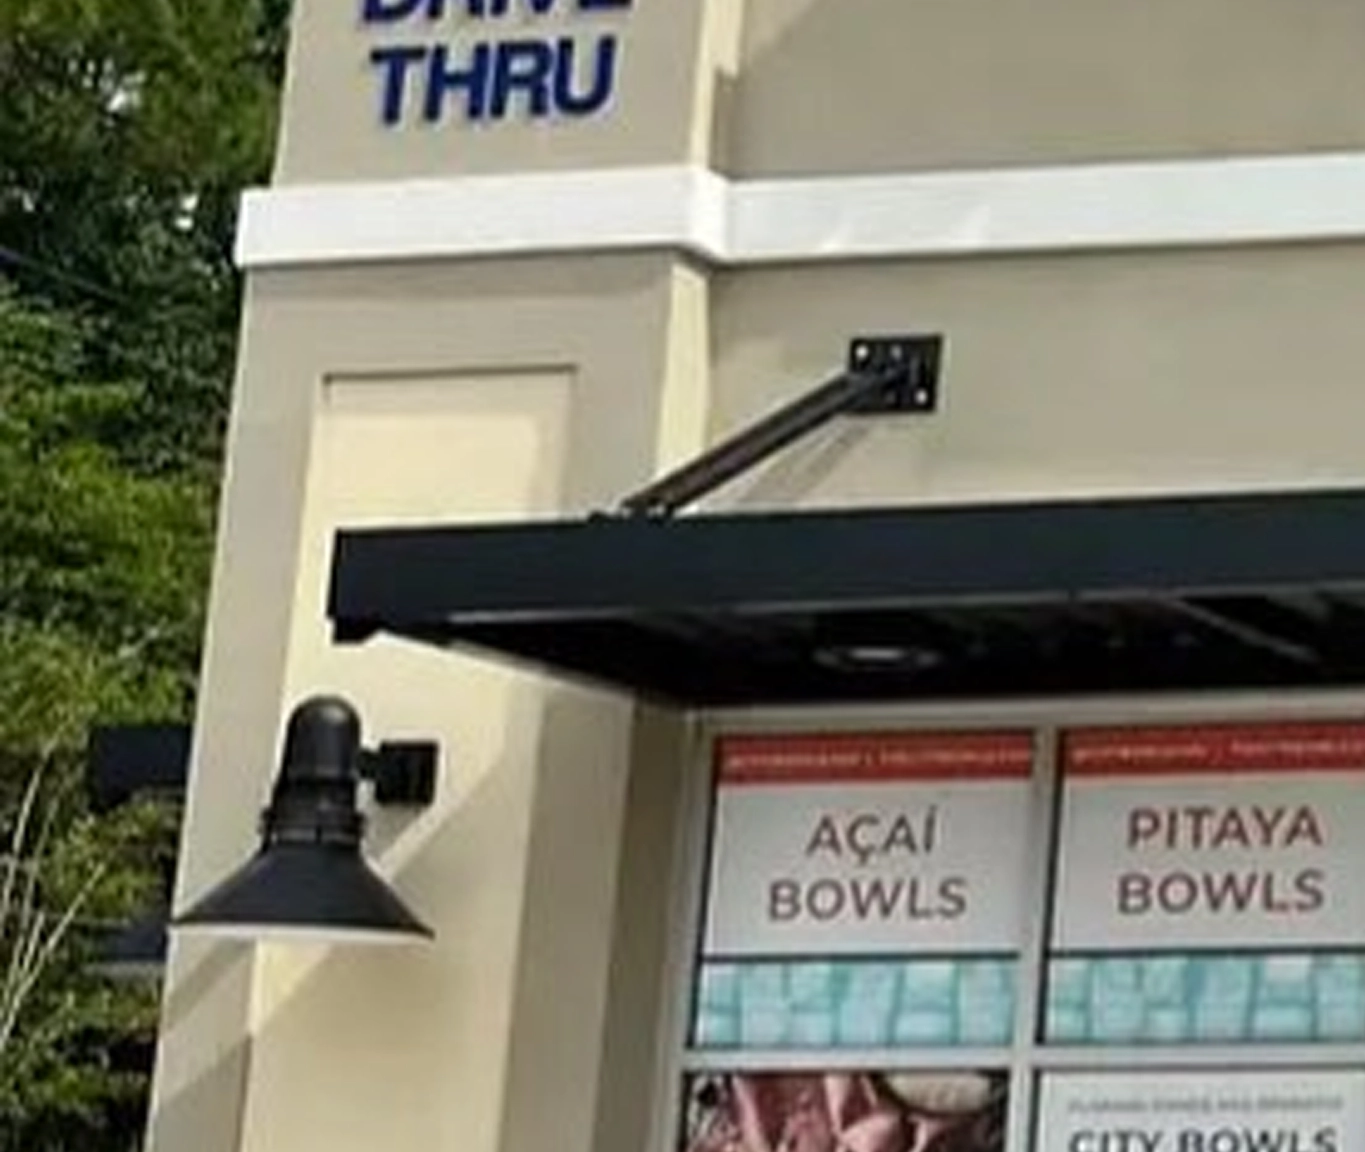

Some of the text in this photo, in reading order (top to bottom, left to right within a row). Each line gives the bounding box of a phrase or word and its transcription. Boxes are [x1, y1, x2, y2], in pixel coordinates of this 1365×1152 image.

[370, 34, 617, 125] THRU
[805, 805, 938, 866] AÇAÍ
[1127, 806, 1324, 847] PITAYA
[767, 877, 967, 922] BOWLS
[1116, 871, 1326, 915] BOWLS
